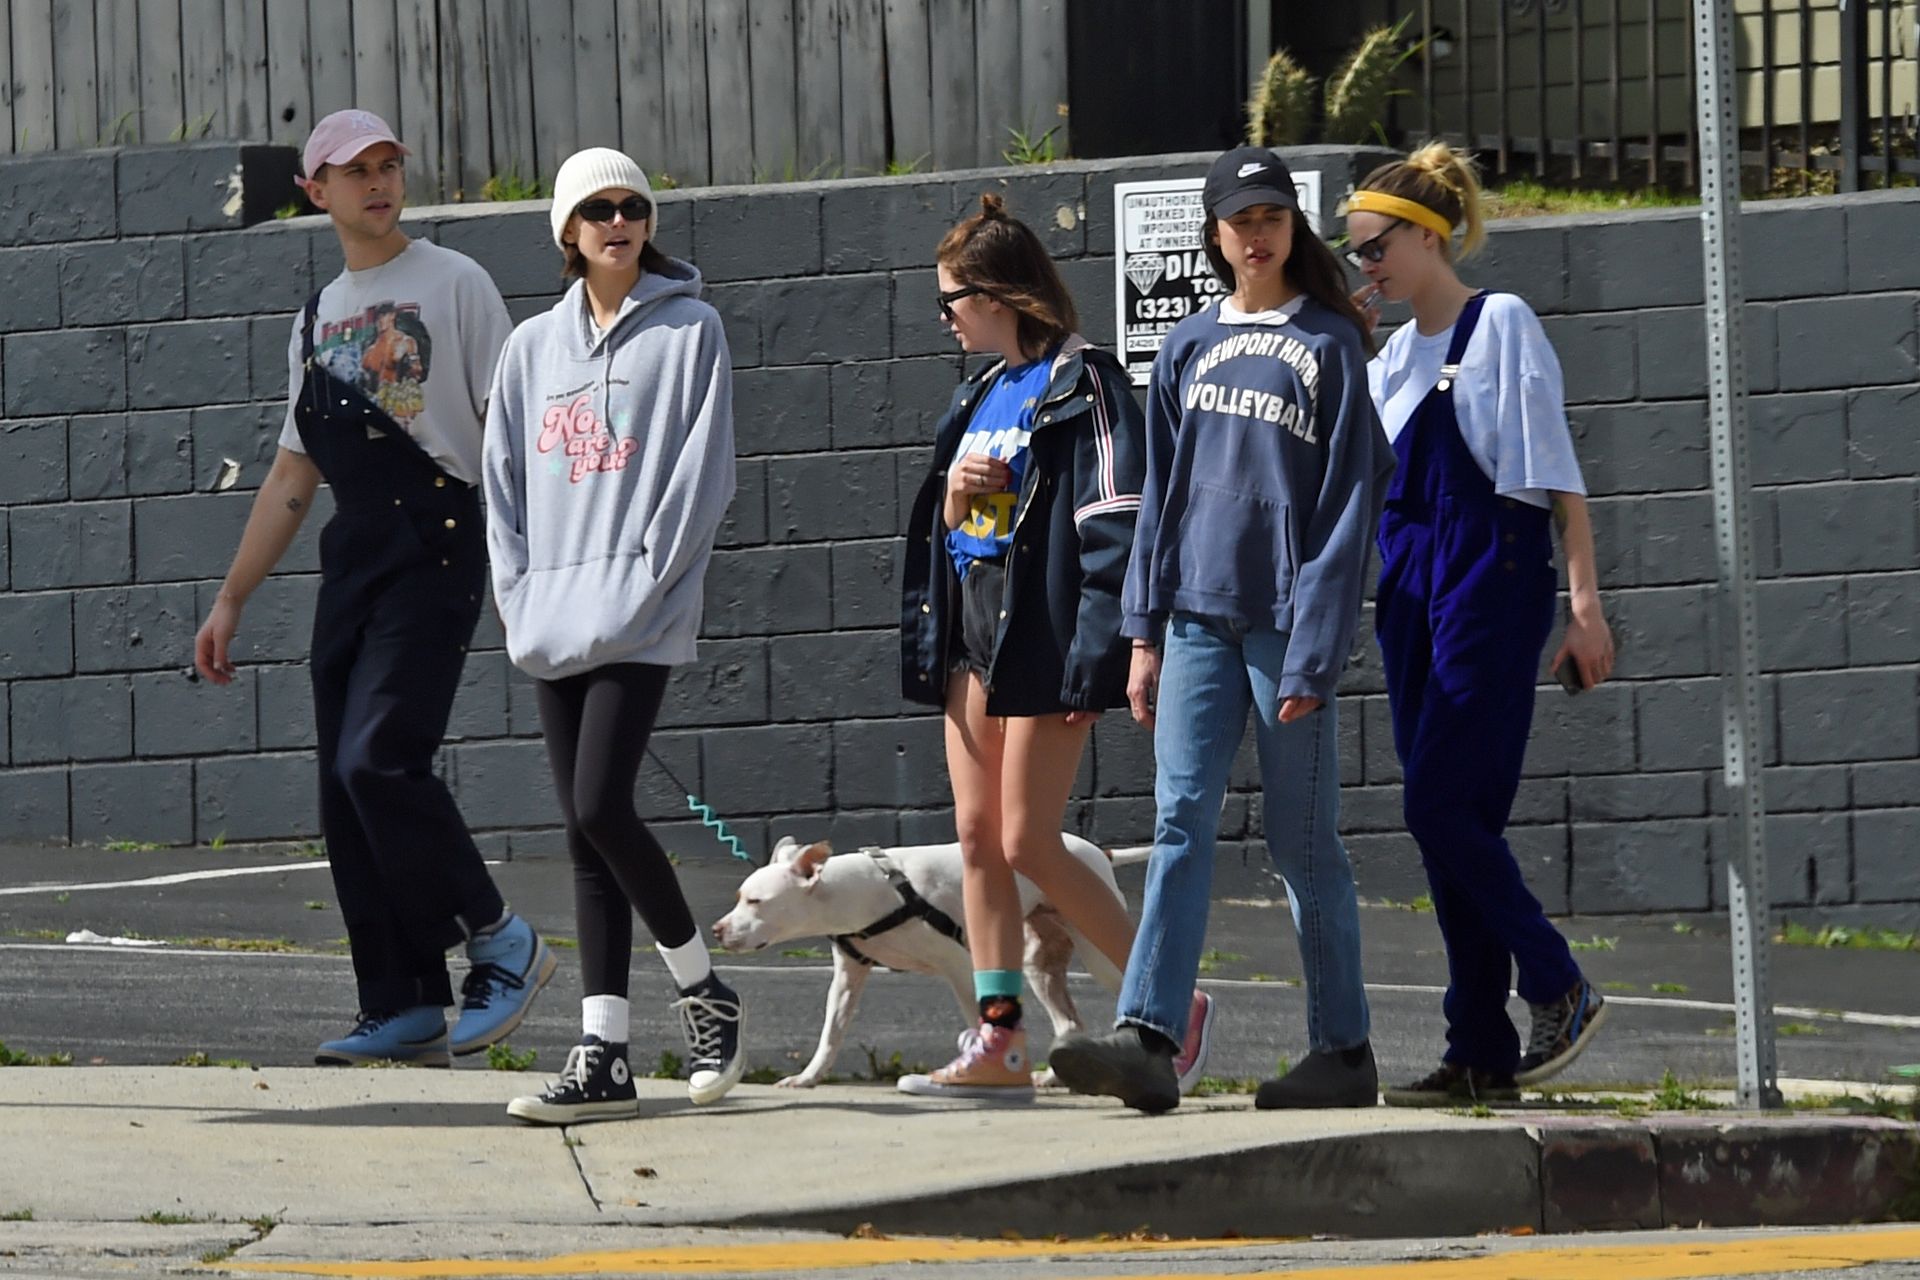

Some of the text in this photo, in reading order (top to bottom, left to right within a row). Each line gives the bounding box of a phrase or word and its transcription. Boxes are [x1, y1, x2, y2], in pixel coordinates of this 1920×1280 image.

[1144, 206, 1205, 220] PARKED VE
[1138, 221, 1200, 234] IMPOUNDED
[1139, 235, 1201, 249] AT OWNERS
[1165, 250, 1212, 281] DIA
[1190, 278, 1228, 294] TO
[1135, 296, 1192, 319] (323)
[1195, 332, 1284, 382] NEWPORT
[537, 393, 603, 454] No,
[1186, 383, 1317, 444] VOLLEYBALL
[565, 432, 612, 457] are
[569, 437, 639, 483] you?
